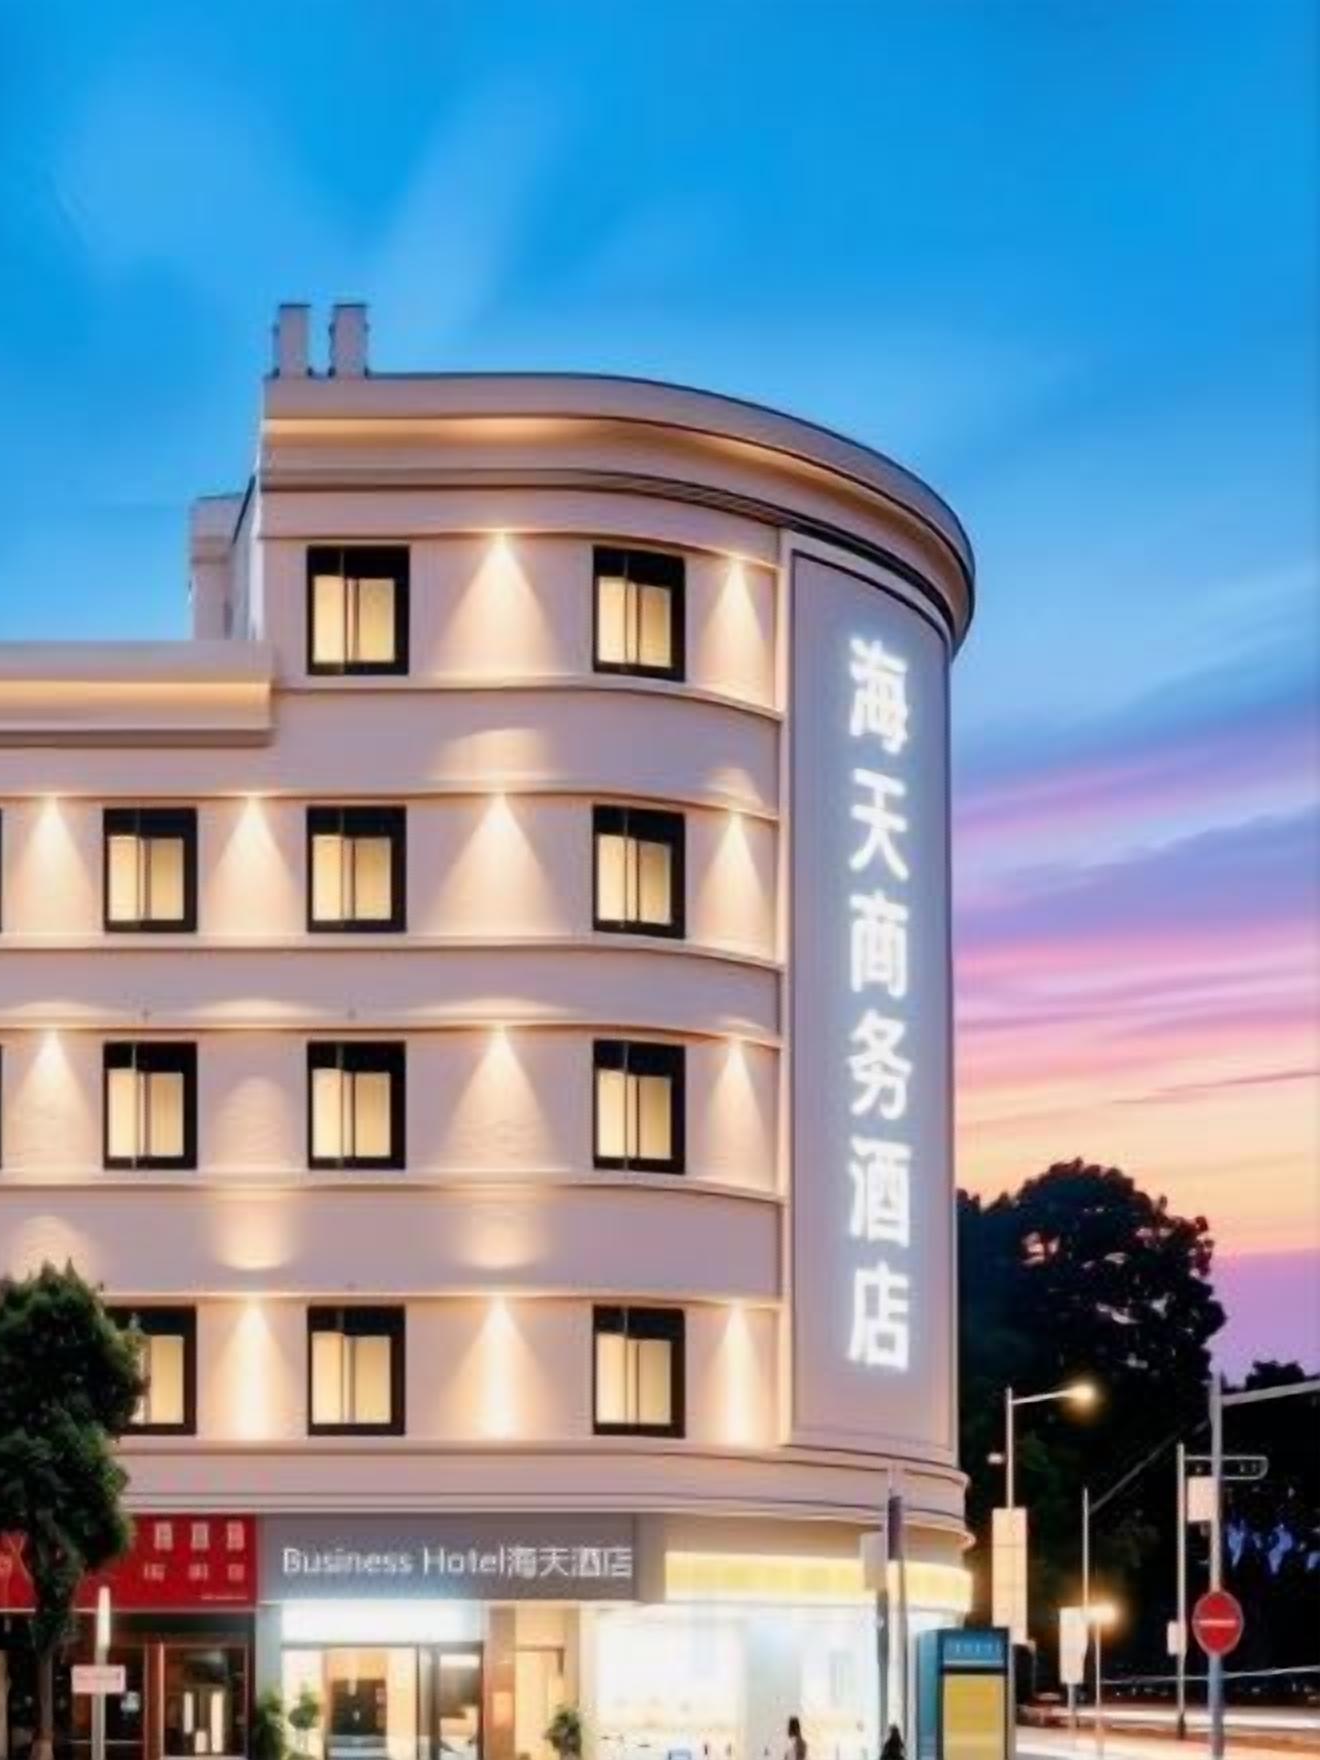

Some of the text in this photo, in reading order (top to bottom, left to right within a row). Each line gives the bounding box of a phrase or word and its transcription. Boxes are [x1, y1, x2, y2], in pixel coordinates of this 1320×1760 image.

[848, 637, 911, 1371] 海天商务酒店
[282, 1547, 413, 1577] Business
[424, 1545, 504, 1577] Hotel
[508, 1546, 632, 1579] 海天酒店
